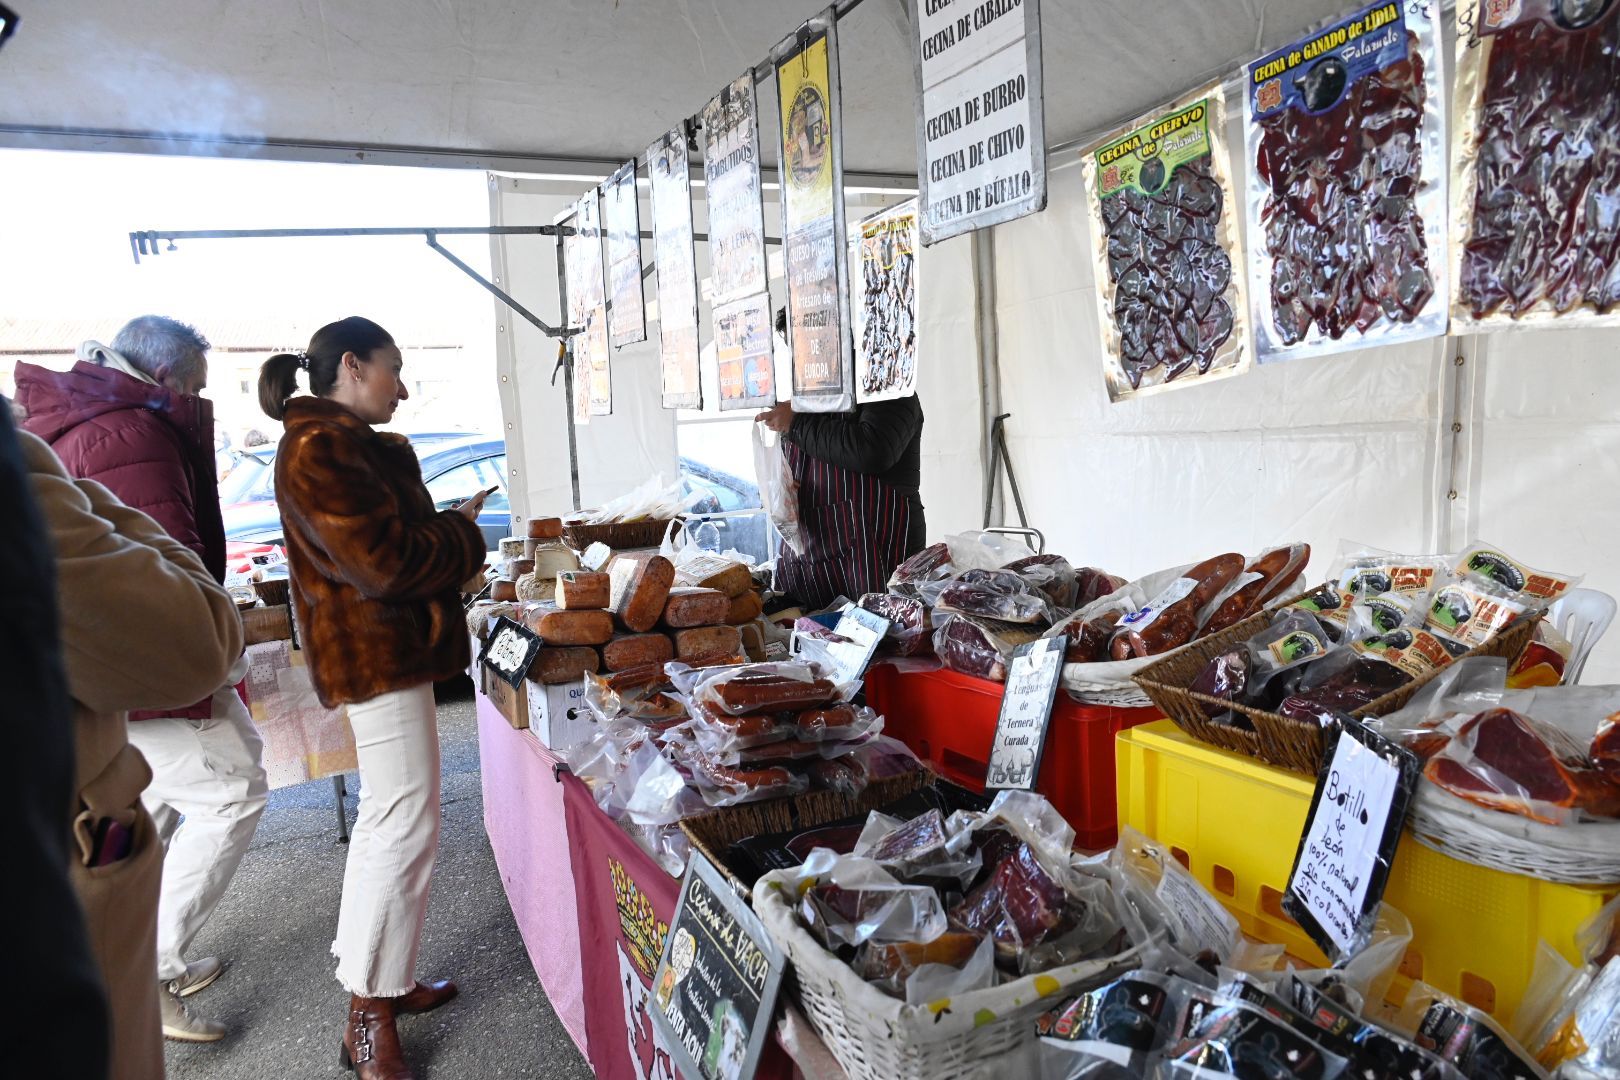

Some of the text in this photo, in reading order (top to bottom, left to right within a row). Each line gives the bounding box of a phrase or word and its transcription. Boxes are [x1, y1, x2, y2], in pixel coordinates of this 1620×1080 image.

[923, 27, 955, 61] CECINA
[957, 14, 972, 42] DE
[1254, 57, 1286, 83] CECINA
[1288, 50, 1302, 68] de
[1304, 28, 1346, 60] GANADO
[1348, 21, 1363, 40] de
[927, 74, 1026, 142] CECINA DE BURRO
[931, 124, 1025, 183] CECINA DE CHIVO
[1100, 135, 1141, 165] CECINA
[1150, 106, 1204, 140] CIERVO
[1142, 142, 1156, 157] de
[711, 142, 753, 180] EMBUTIDOS
[930, 194, 963, 225] CECINA
[966, 185, 982, 214] DE
[985, 170, 1031, 209] BÚFALO
[790, 245, 809, 263] QUESO
[796, 273, 803, 286] de
[823, 291, 832, 304] de
[810, 339, 820, 355] DE
[804, 362, 829, 379] EUROPA
[1007, 717, 1034, 729] Ternera
[1020, 701, 1029, 711] de
[1004, 735, 1029, 747] Curada
[1326, 770, 1369, 826] Botillo
[1335, 812, 1346, 837] de
[1309, 842, 1360, 897] 100% natural
[720, 919, 735, 949] de
[735, 929, 769, 990] VACA
[664, 1001, 686, 1040] VENTA
